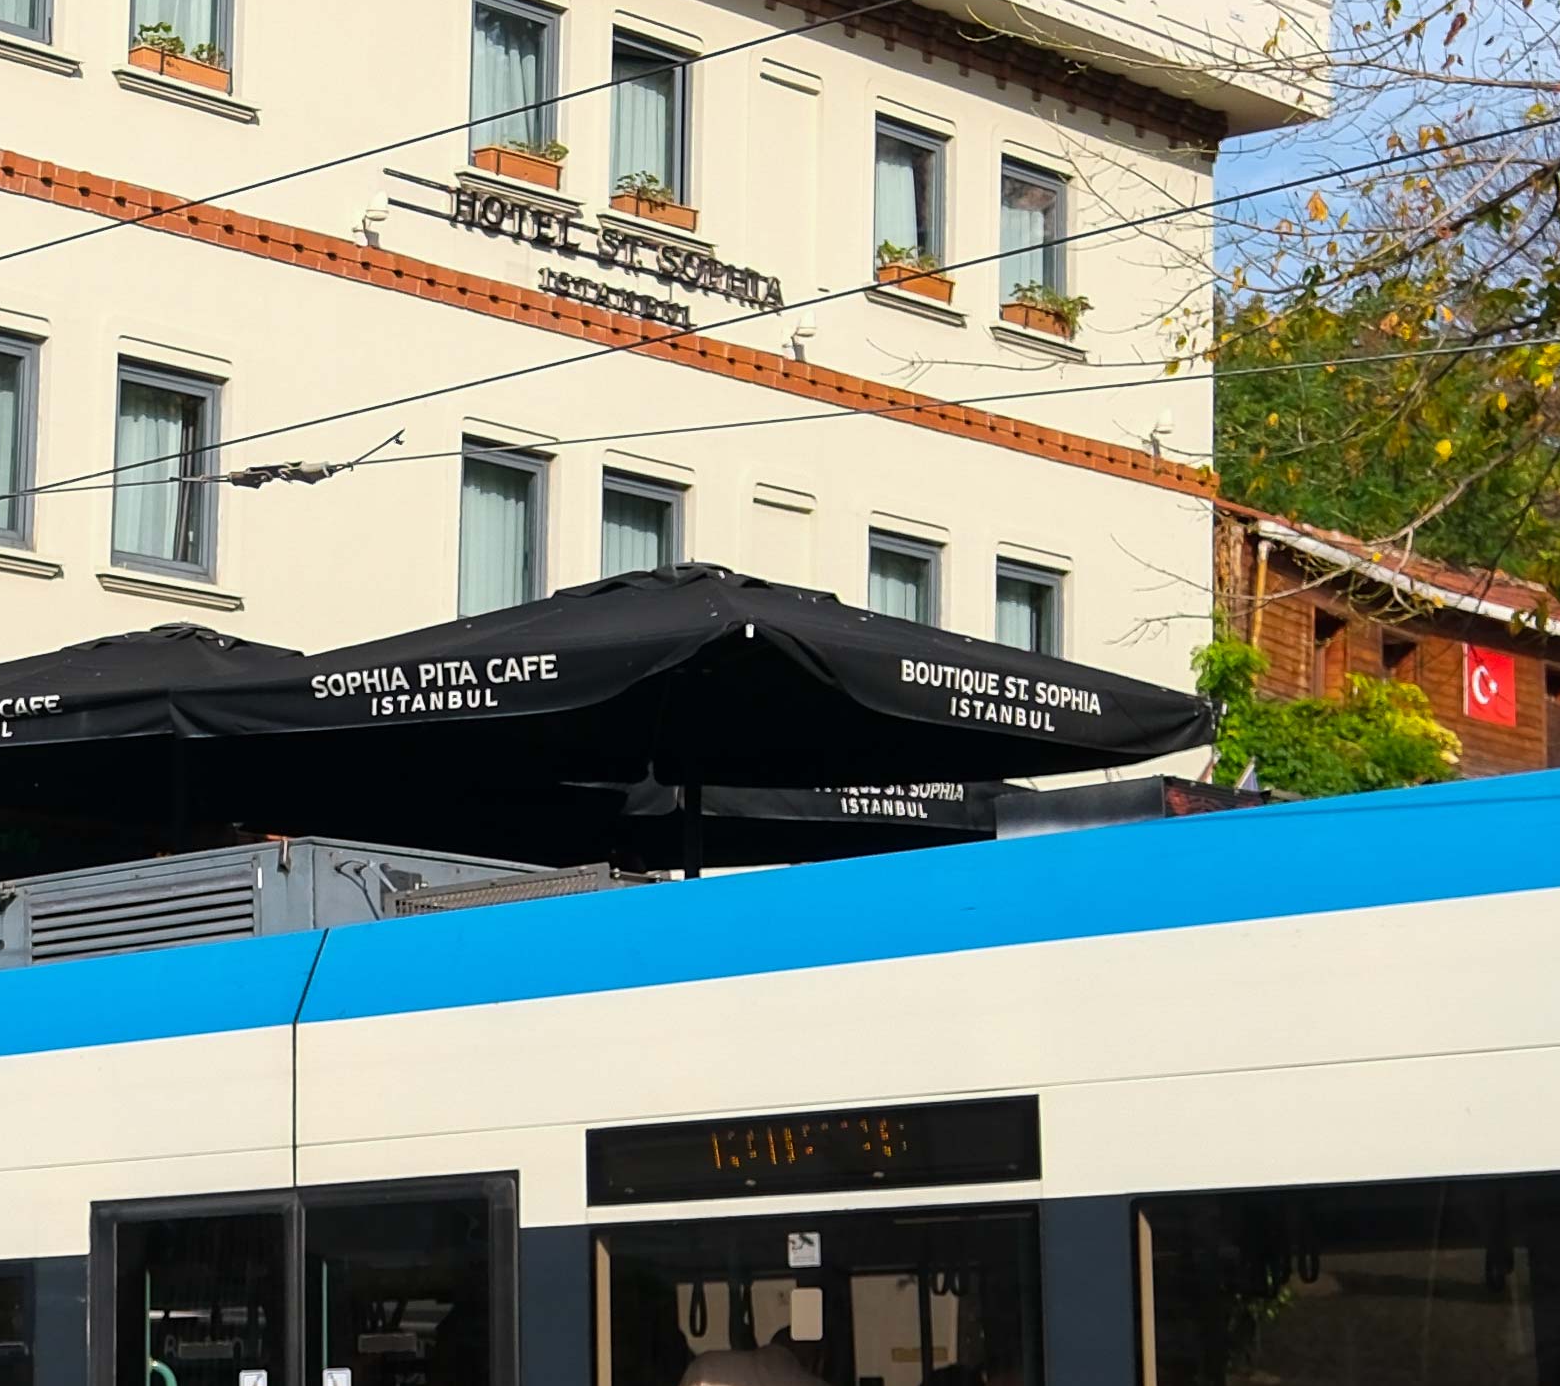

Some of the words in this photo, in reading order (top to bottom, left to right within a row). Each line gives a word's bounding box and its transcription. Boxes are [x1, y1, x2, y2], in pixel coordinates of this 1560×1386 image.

[453, 186, 582, 252] HOTEL
[598, 228, 643, 269] ST.
[658, 245, 785, 308] SOPHIA
[310, 666, 411, 699] SOPHIA
[418, 660, 478, 688] PITA
[486, 653, 559, 684] CAFE
[900, 659, 1000, 697] BOUTIQUE
[1004, 675, 1029, 701] ST.
[1034, 682, 1102, 716] SOPHIA
[371, 688, 499, 716] ISTANBUL
[949, 696, 1055, 733] ISTANBUL
[840, 797, 928, 819] ISTANBUL
[908, 782, 965, 802] SOPHIA
